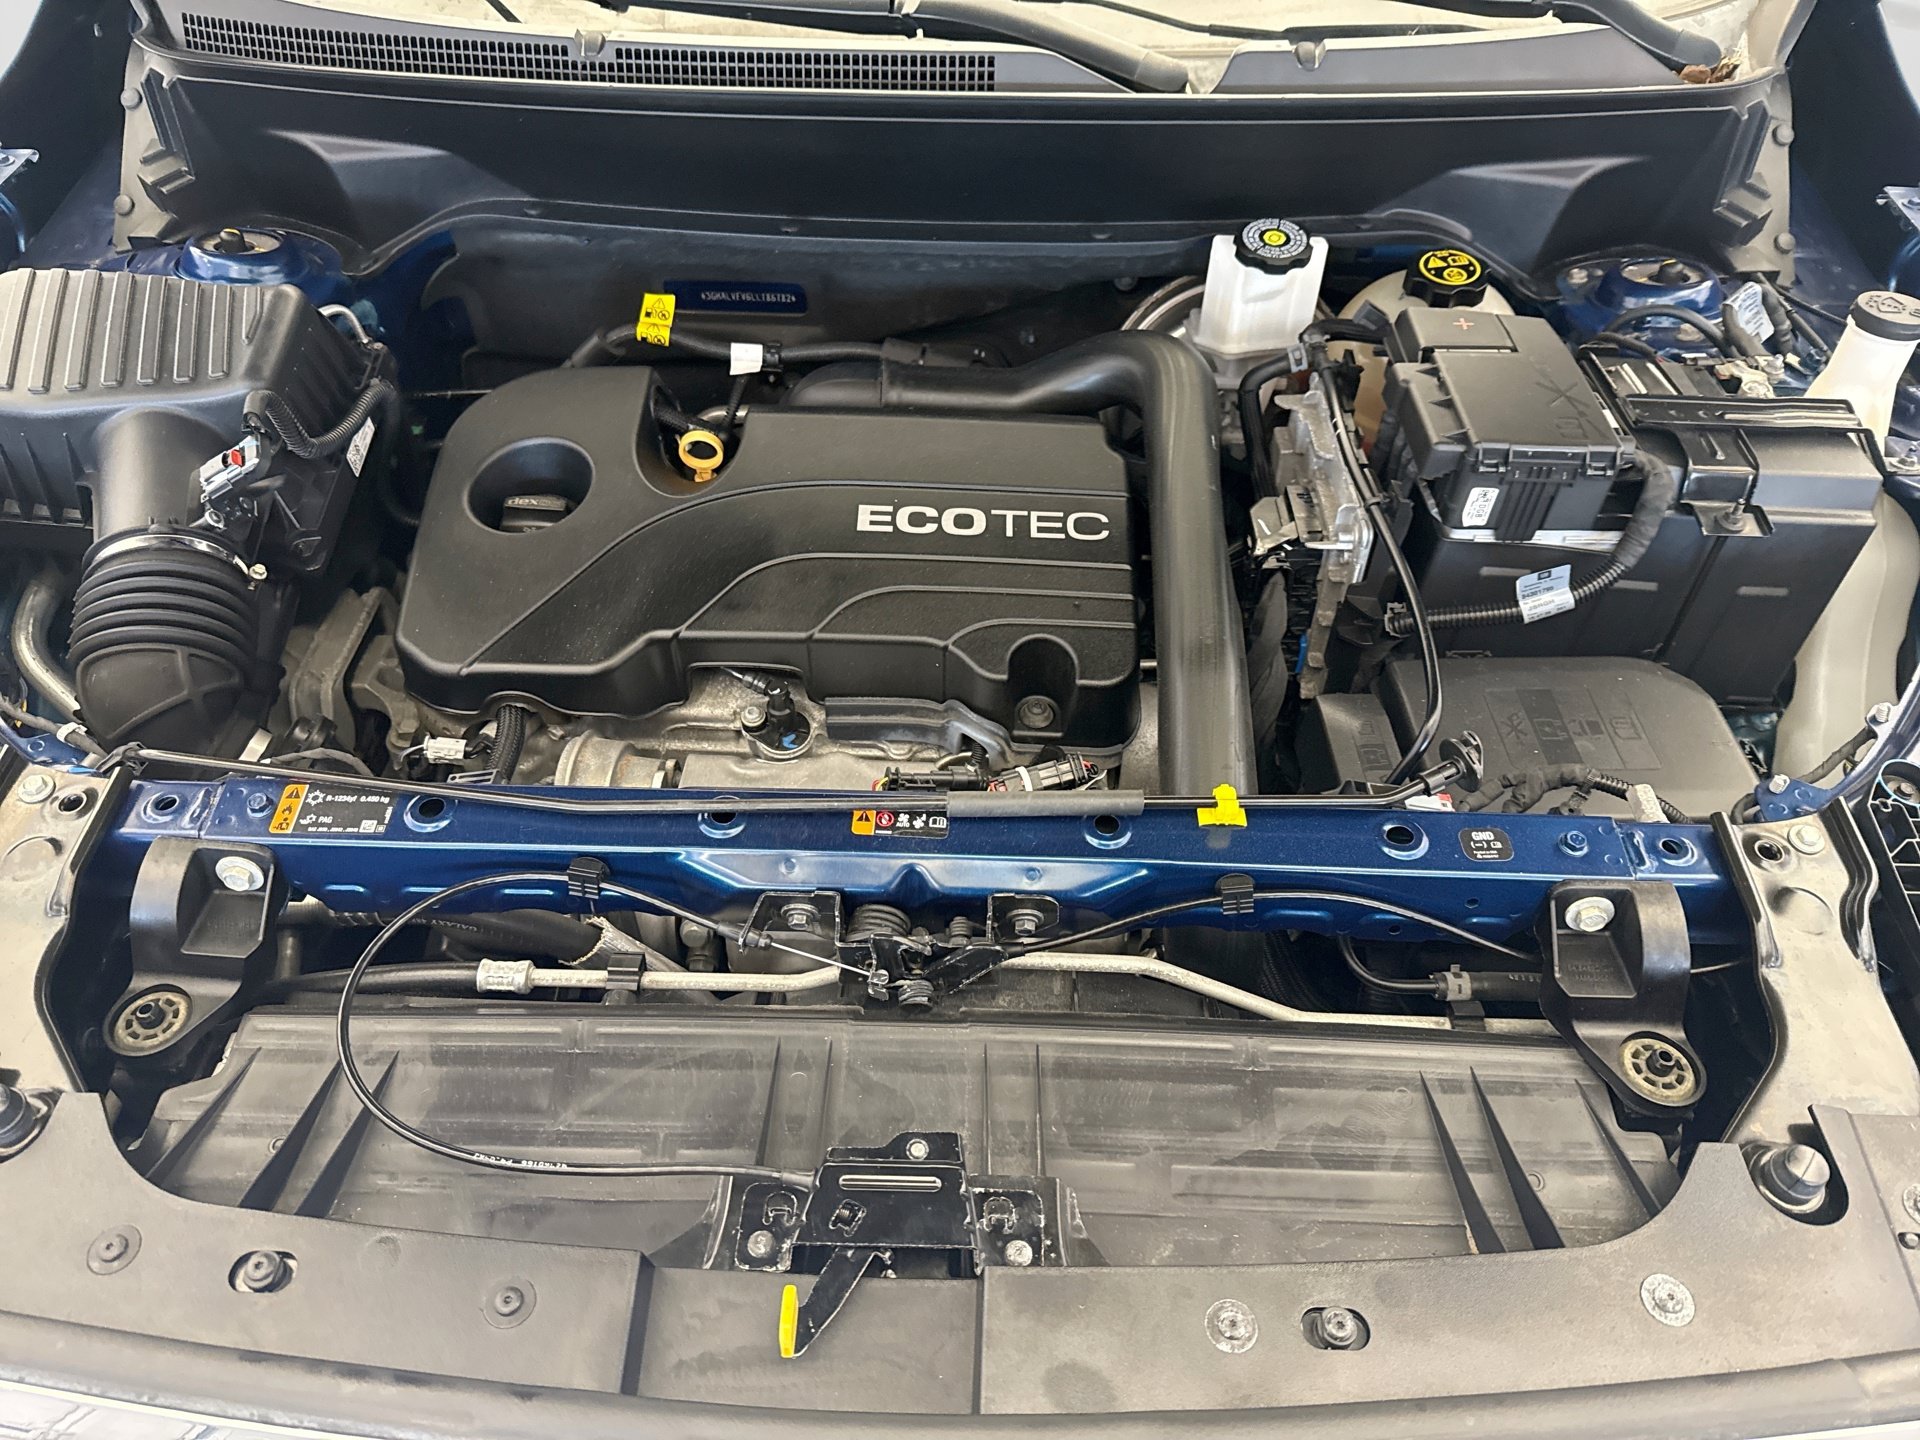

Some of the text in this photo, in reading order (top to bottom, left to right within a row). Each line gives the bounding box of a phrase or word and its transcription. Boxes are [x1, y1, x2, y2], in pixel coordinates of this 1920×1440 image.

[856, 504, 1110, 541] ECOTEC
[380, 796, 390, 804] kg
[1471, 831, 1495, 840] GND
